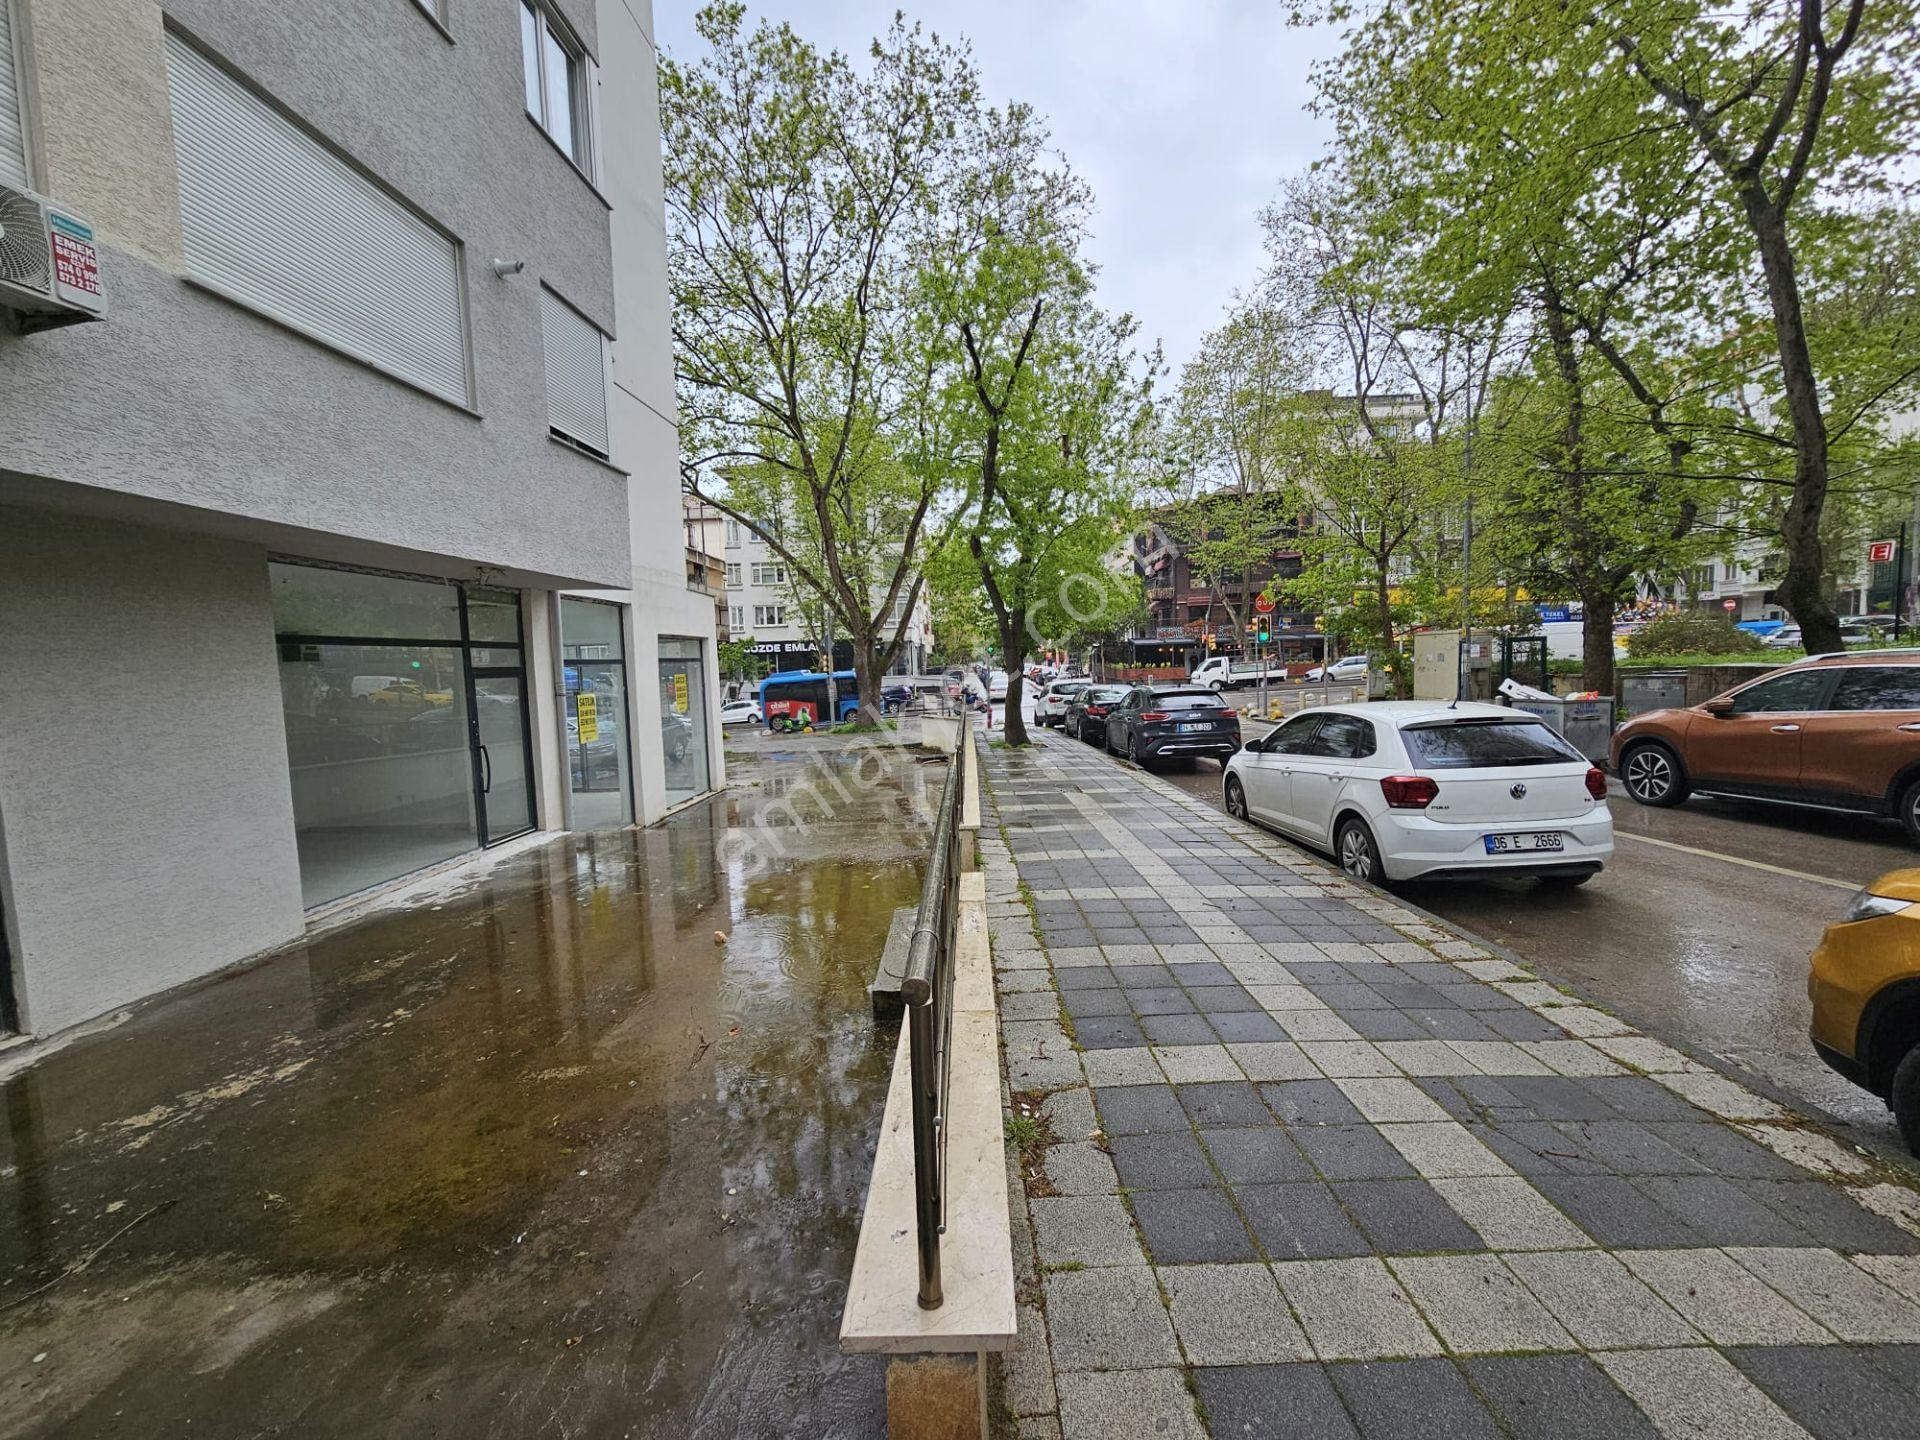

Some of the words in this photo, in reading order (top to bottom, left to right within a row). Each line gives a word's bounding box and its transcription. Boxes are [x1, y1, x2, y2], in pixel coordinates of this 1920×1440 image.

[54, 233, 96, 258] EMEK
[785, 642, 819, 652] EMLA
[1493, 836, 1507, 849] 06
[1512, 835, 1521, 848] E
[1533, 834, 1561, 848] 2666
